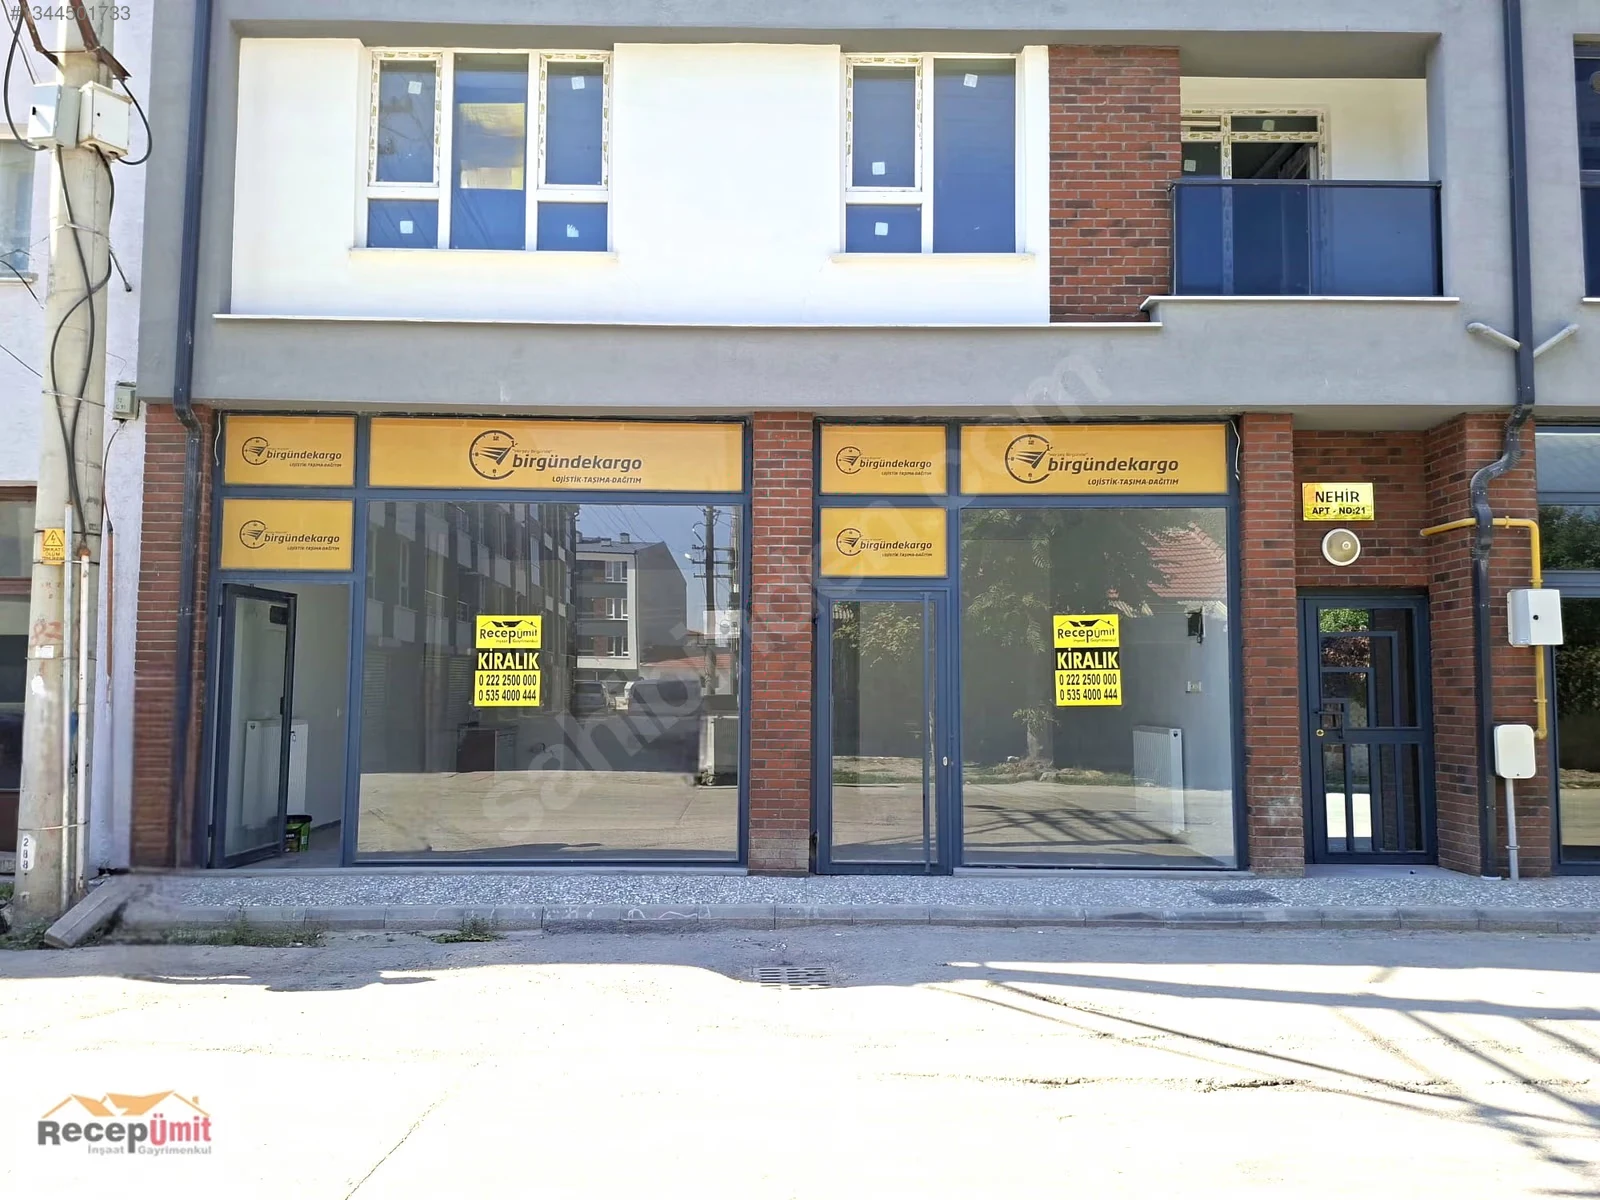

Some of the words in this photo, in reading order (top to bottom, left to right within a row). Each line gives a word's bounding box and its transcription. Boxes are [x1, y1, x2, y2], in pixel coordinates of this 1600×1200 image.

[266, 450, 342, 461] birgündekargo
[512, 453, 642, 472] birgündekargo
[860, 459, 932, 469] birgündekargo
[1048, 457, 1179, 474] birgündekargo
[1315, 488, 1360, 503] NEHİR
[1312, 507, 1330, 515] APT
[1338, 507, 1366, 515] NO:21
[264, 534, 340, 544] birgündekargo
[860, 541, 932, 551] birgündekargo
[478, 648, 540, 670] KİRALIK
[1057, 648, 1119, 669] KİRALIK
[479, 674, 484, 686] 0
[486, 674, 500, 686] 222
[502, 674, 521, 686] 2500
[523, 674, 537, 686] 000
[1059, 675, 1064, 685] 0
[1066, 674, 1080, 686] 222
[1083, 674, 1101, 685] 2500
[1103, 673, 1117, 685] 000
[479, 689, 484, 701] 0
[486, 689, 500, 701] 535
[502, 689, 520, 701] 4000
[522, 689, 537, 701] 444
[1060, 690, 1065, 701] 0
[1067, 689, 1081, 701] 535
[1083, 689, 1102, 700] 4000
[1104, 688, 1118, 699] 444
